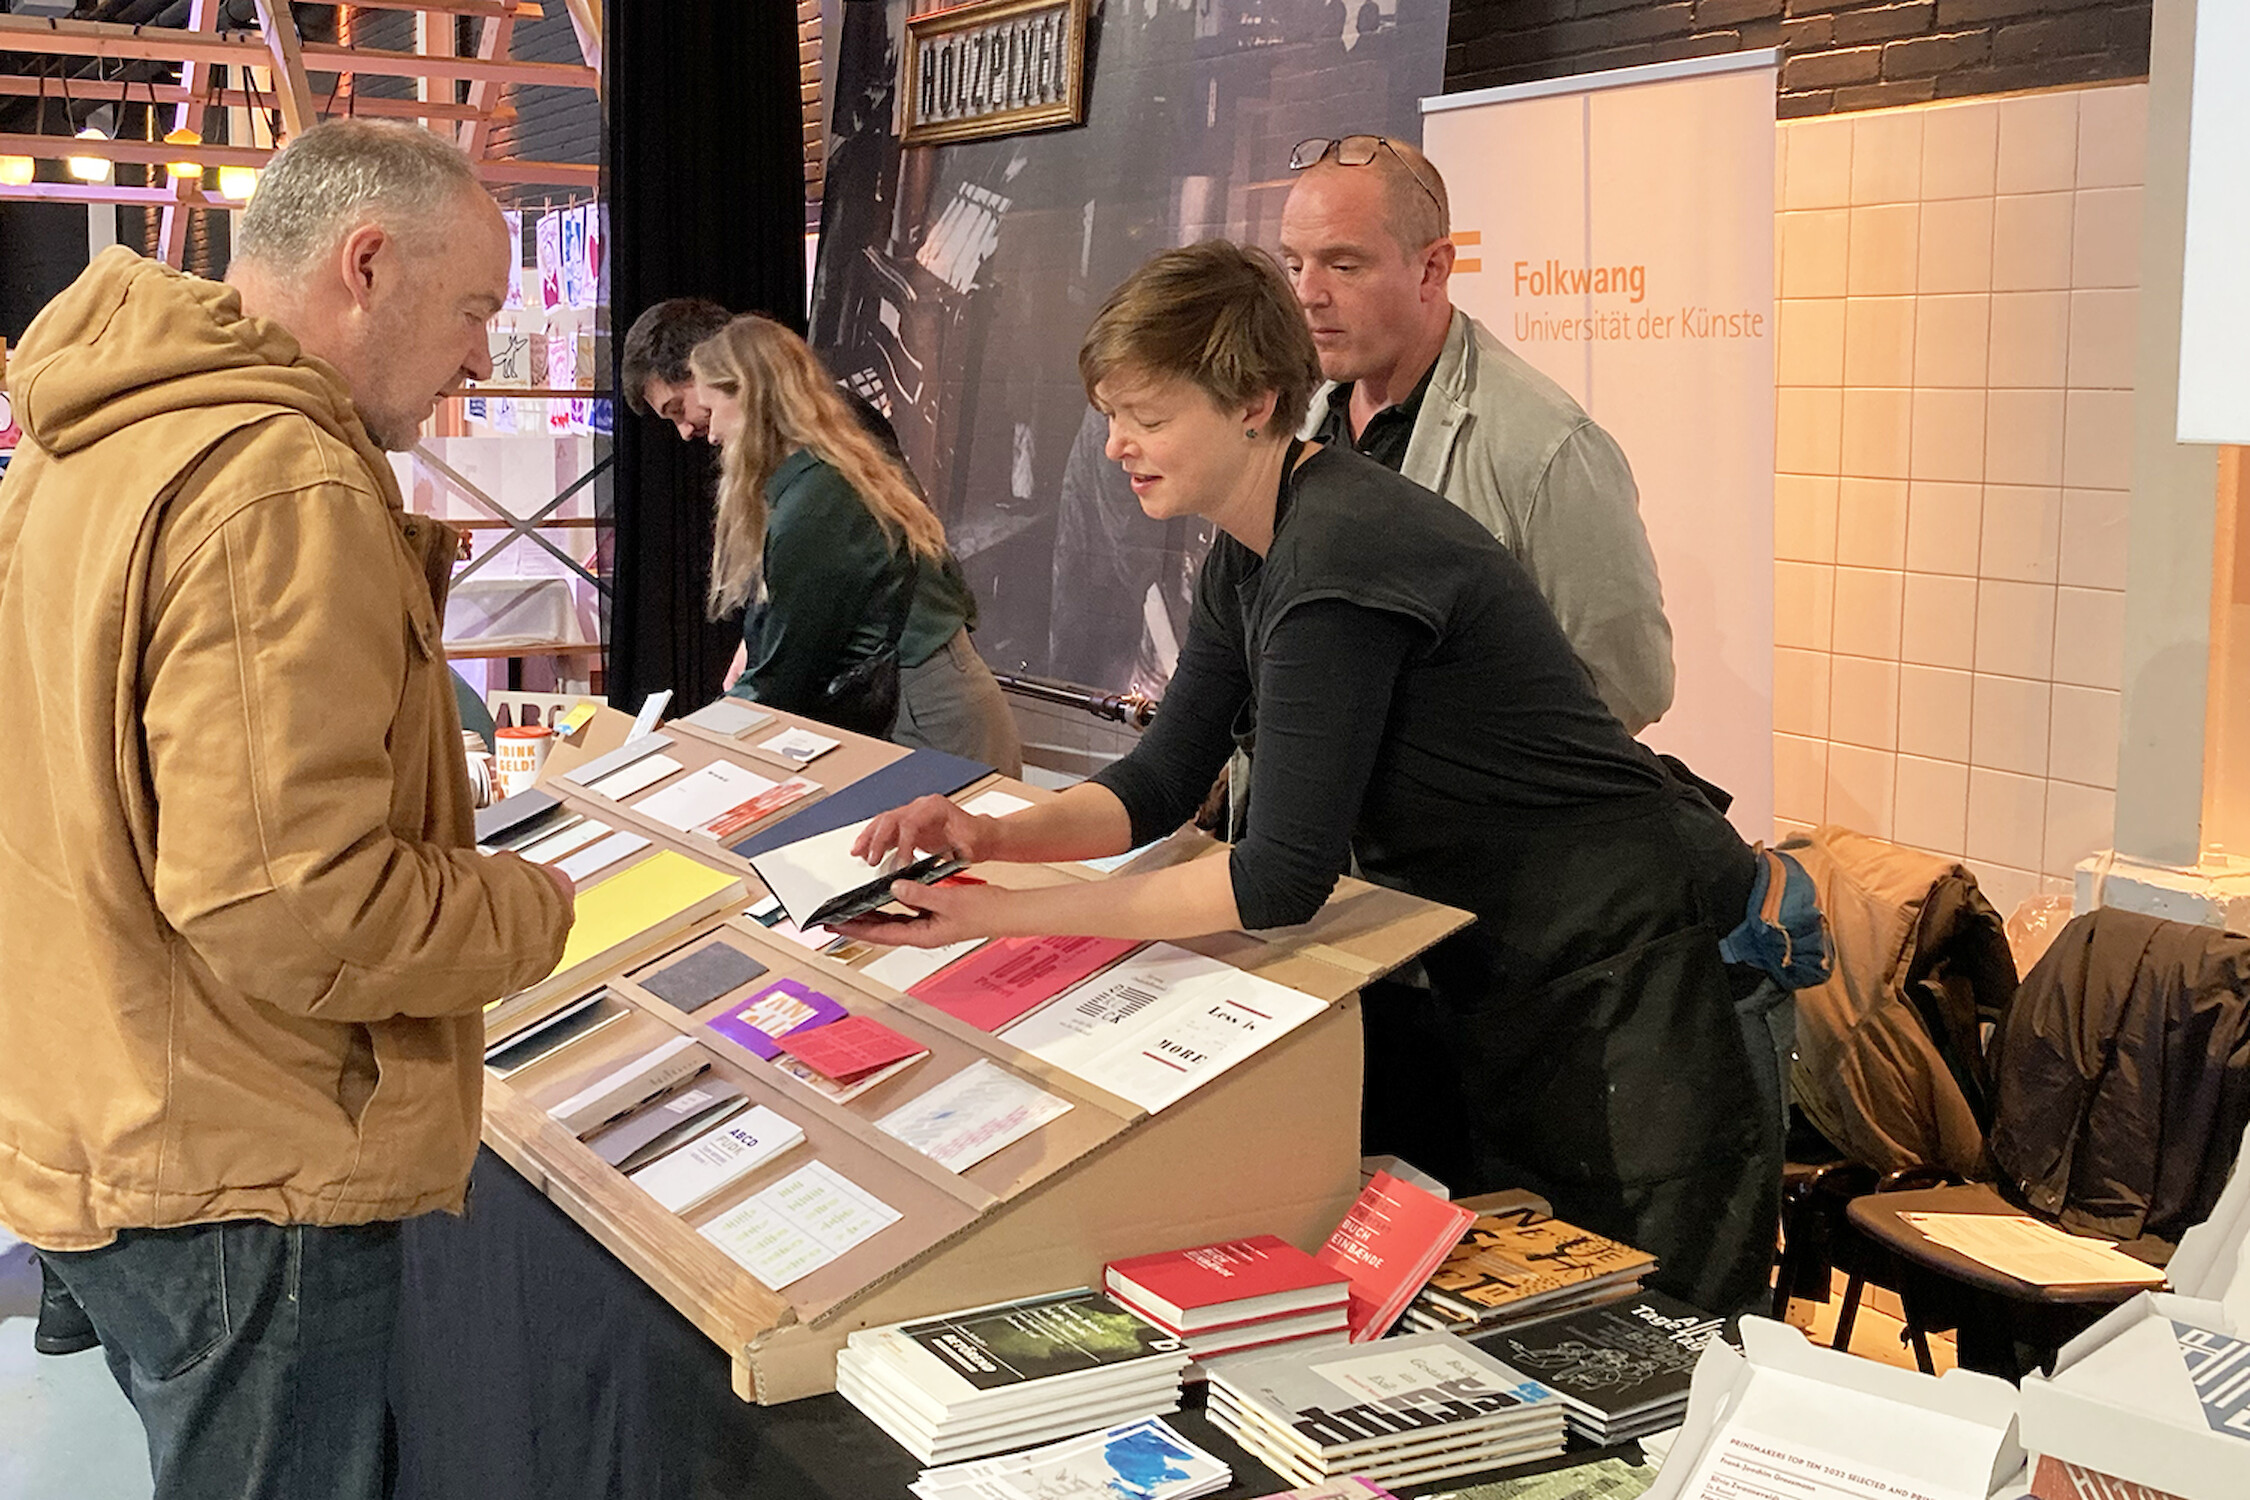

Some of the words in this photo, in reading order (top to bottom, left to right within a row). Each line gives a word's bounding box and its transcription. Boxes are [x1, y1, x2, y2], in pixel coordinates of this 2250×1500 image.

[1514, 260, 1645, 303] Folkwang
[1514, 311, 1631, 342] Universität
[1637, 309, 1675, 340] der
[1682, 306, 1764, 338] Künste
[1153, 1038, 1208, 1065] MORE
[728, 1128, 759, 1148] ABCD
[1341, 1218, 1372, 1241] BUCH
[1330, 1233, 1385, 1269] EINBÆNDE
[1730, 1438, 1786, 1460] PRINTMAKERS
[1788, 1455, 1804, 1465] TOP
[1806, 1460, 1821, 1471] TEN
[1823, 1466, 1846, 1479] 2022
[1847, 1473, 1887, 1491] SELECTED
[1889, 1486, 1909, 1498] AND
